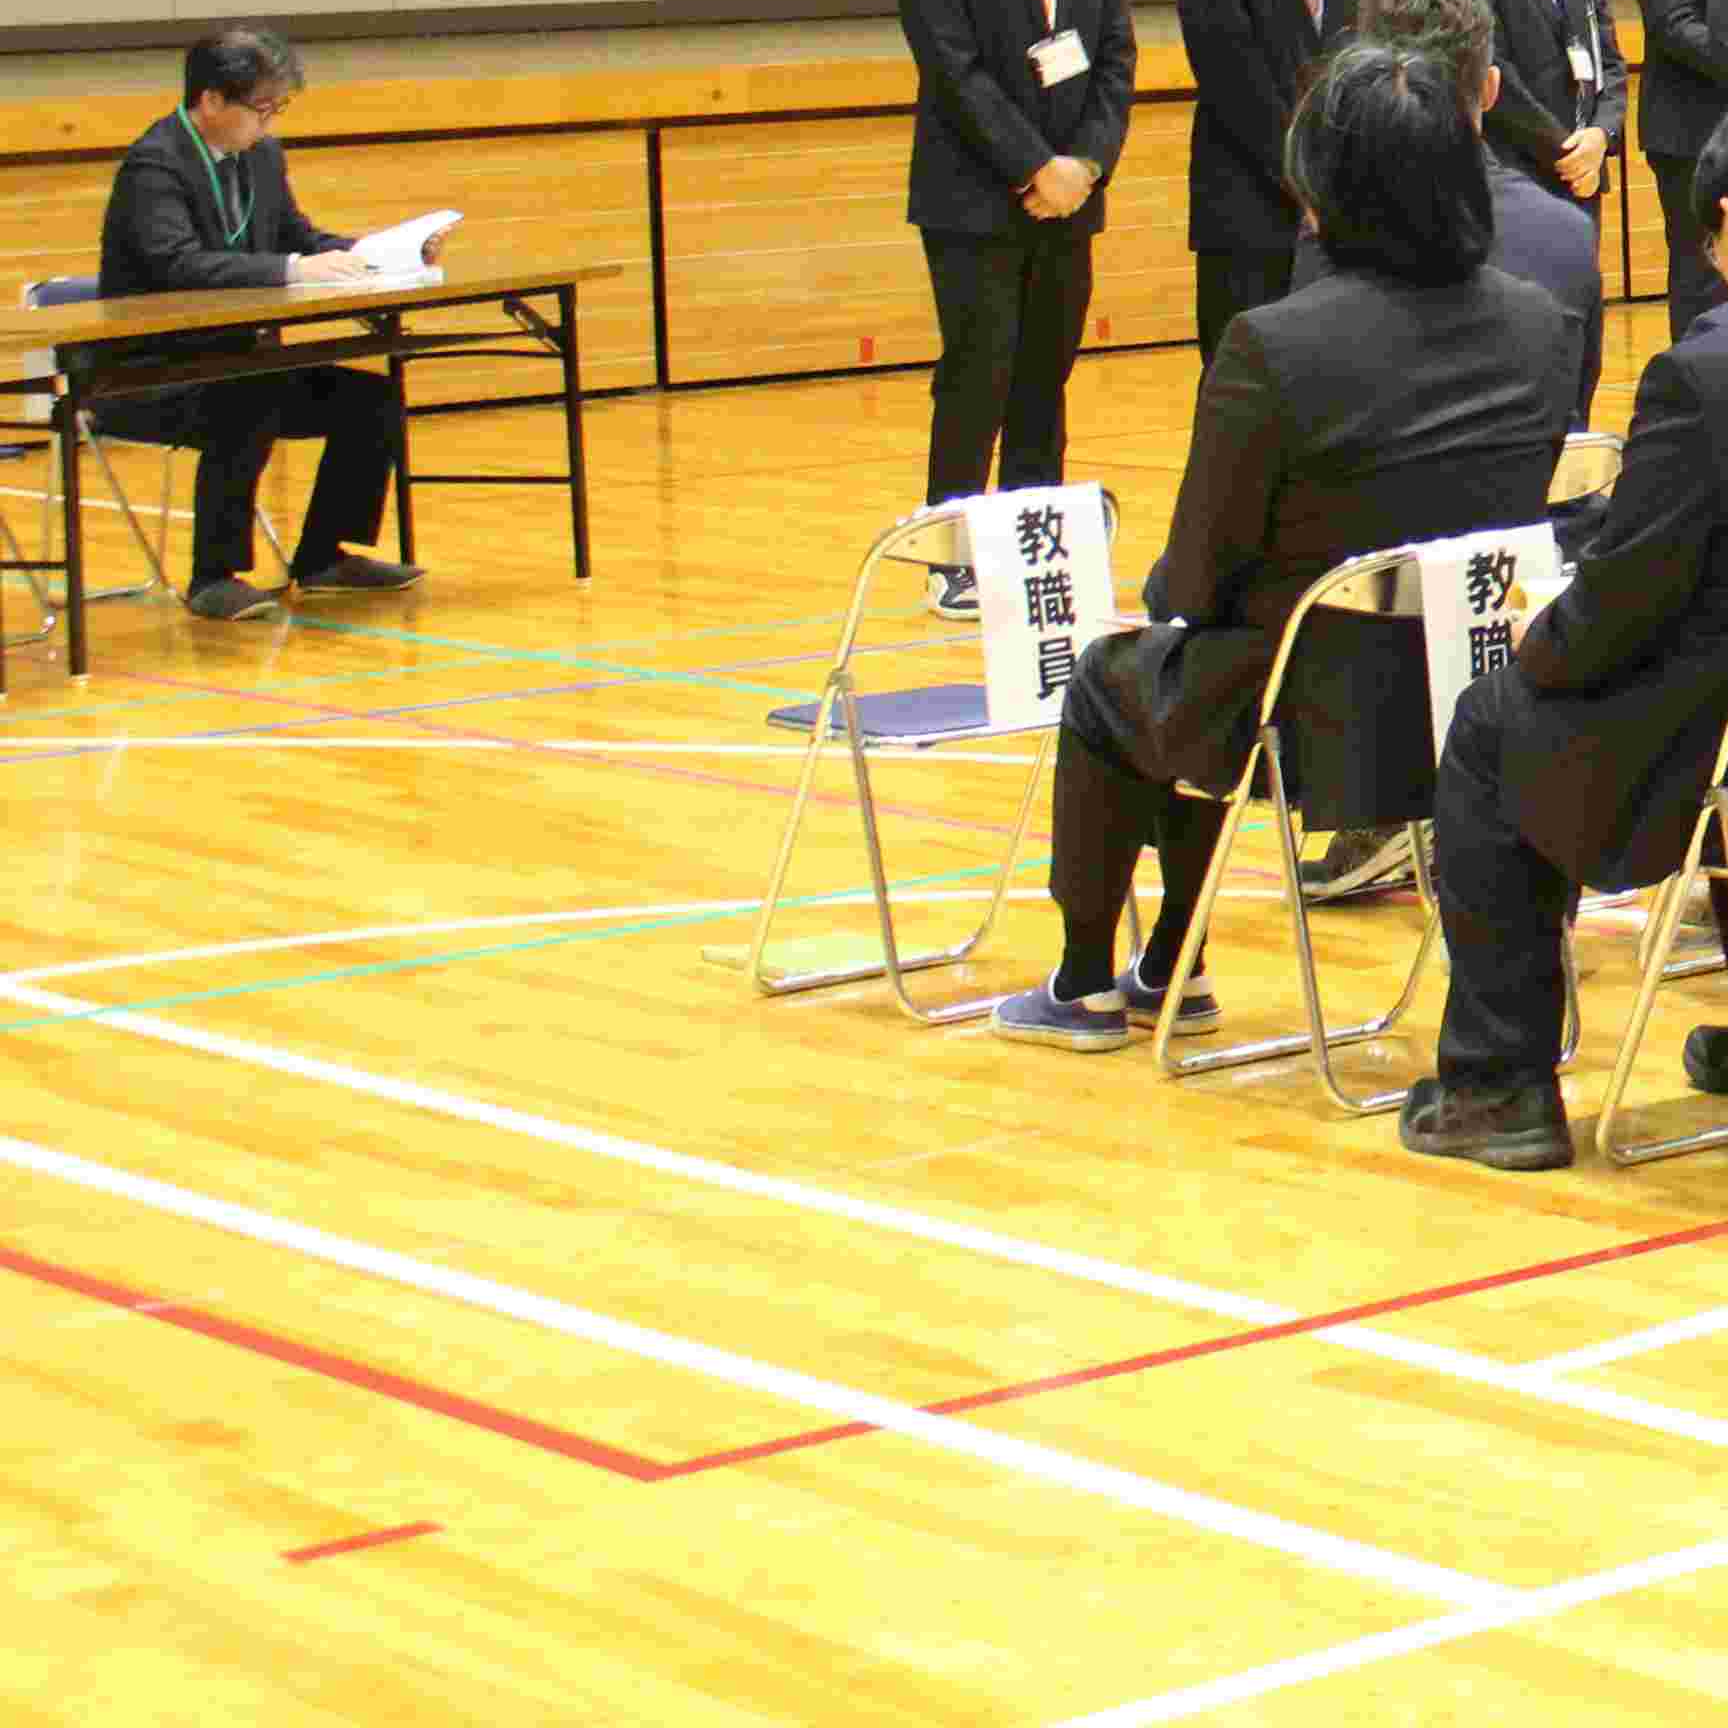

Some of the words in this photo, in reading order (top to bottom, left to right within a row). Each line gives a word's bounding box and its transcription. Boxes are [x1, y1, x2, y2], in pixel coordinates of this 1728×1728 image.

[1015, 504, 1077, 701] 教職員
[1465, 547, 1520, 680] 教職
